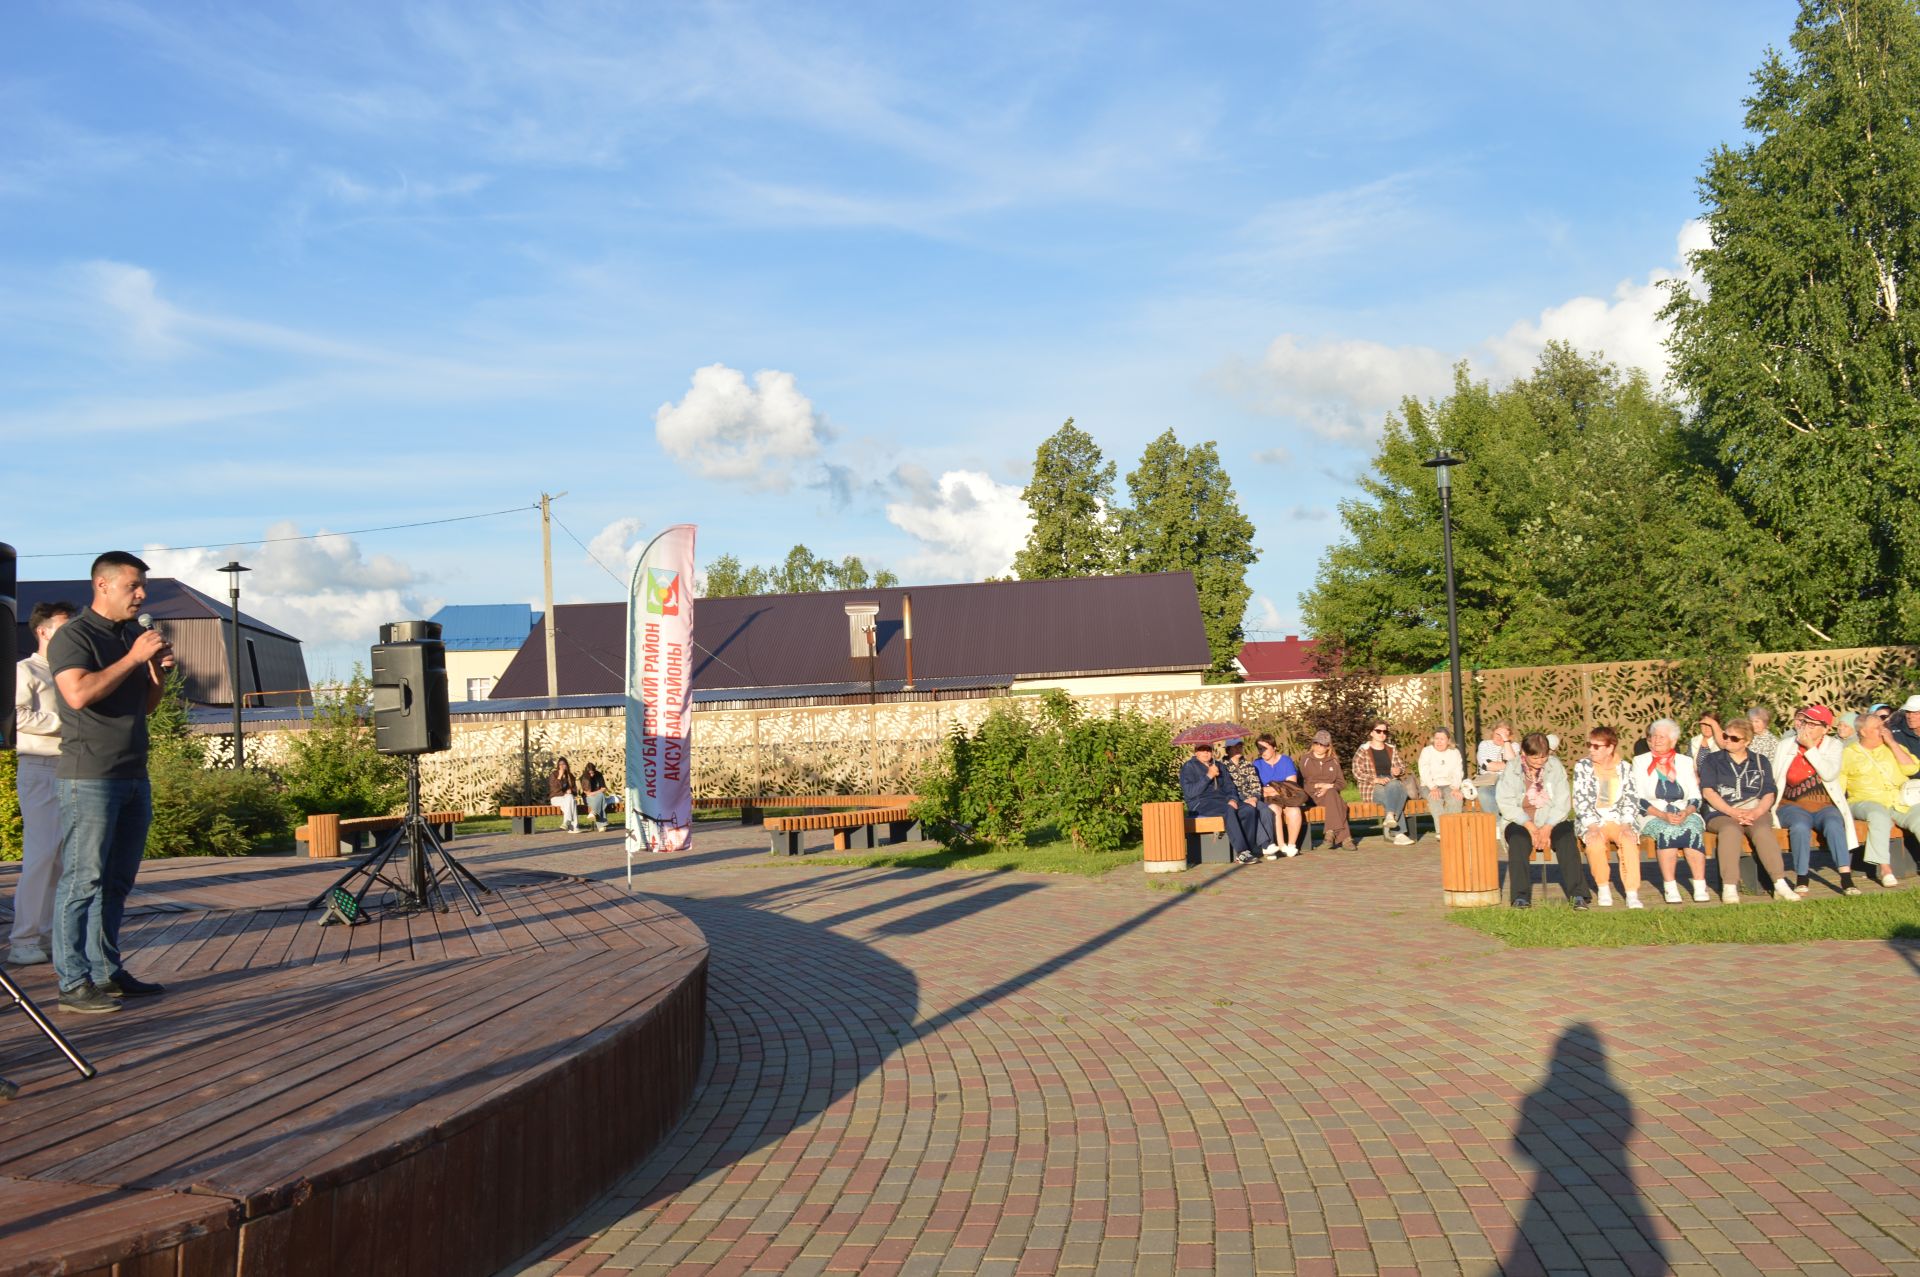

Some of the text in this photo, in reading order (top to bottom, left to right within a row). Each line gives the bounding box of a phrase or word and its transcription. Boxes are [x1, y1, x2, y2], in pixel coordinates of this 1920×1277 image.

[642, 623, 660, 798] АКСУБАЕВСКИЙ РАЙОН
[663, 643, 682, 781] АКСУБАЙ РАЙОНЫ
